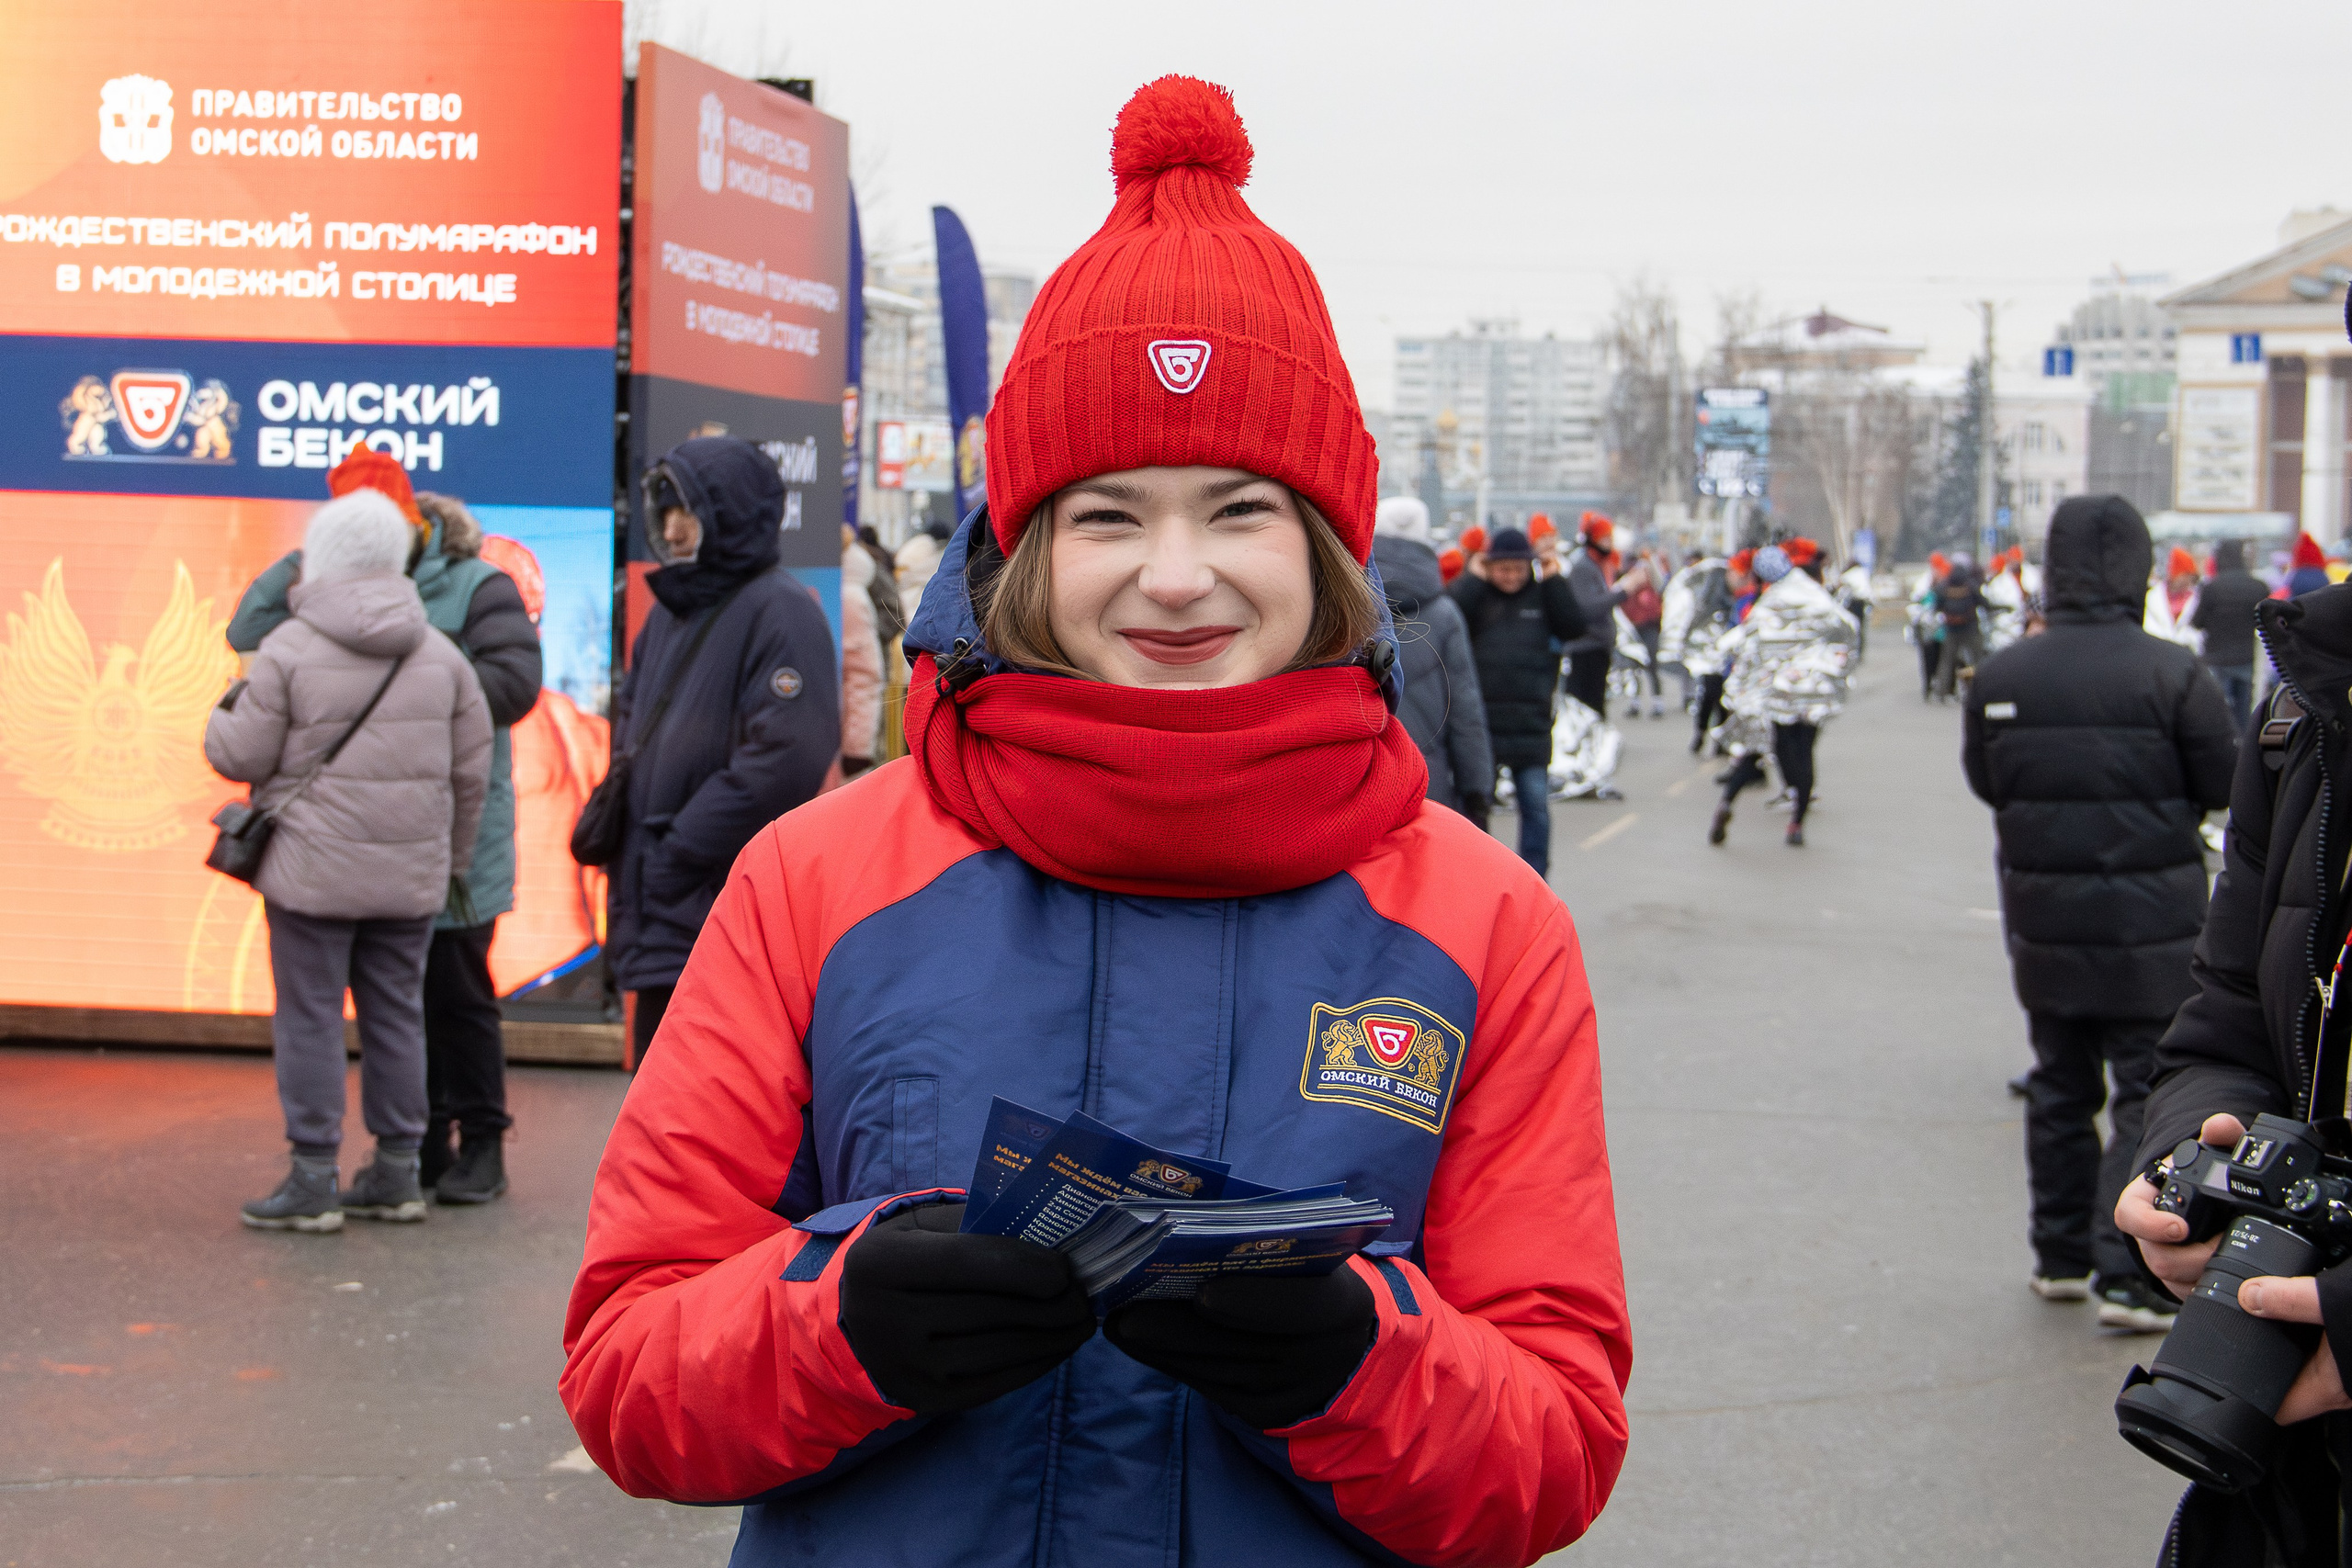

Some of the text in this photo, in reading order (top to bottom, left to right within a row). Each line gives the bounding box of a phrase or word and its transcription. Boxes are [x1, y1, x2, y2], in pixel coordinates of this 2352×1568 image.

[192, 89, 462, 121] ПРАВИТЕЛЬСТВО
[191, 124, 478, 160] ОМСКОЙ ОБЛАСТИ
[0, 211, 597, 255] ОЖДЕСТВЕНСКИЙ ПОЛУМАРАФОН
[56, 261, 517, 307] В МОЛОДЕЖНОЙ СТОЛИЦЕ
[257, 377, 500, 426] ОМСКИЙ
[257, 426, 444, 472] БЕКОН
[1320, 1070, 1438, 1109] ОМСКИЙ БЕКОН
[1048, 1161, 1121, 1200] магазинах
[1055, 1153, 1080, 1169] Мы
[1080, 1167, 1122, 1190] ждём
[1129, 1172, 1165, 1190] ОМСКИЙ
[2231, 1179, 2260, 1196] Nikon
